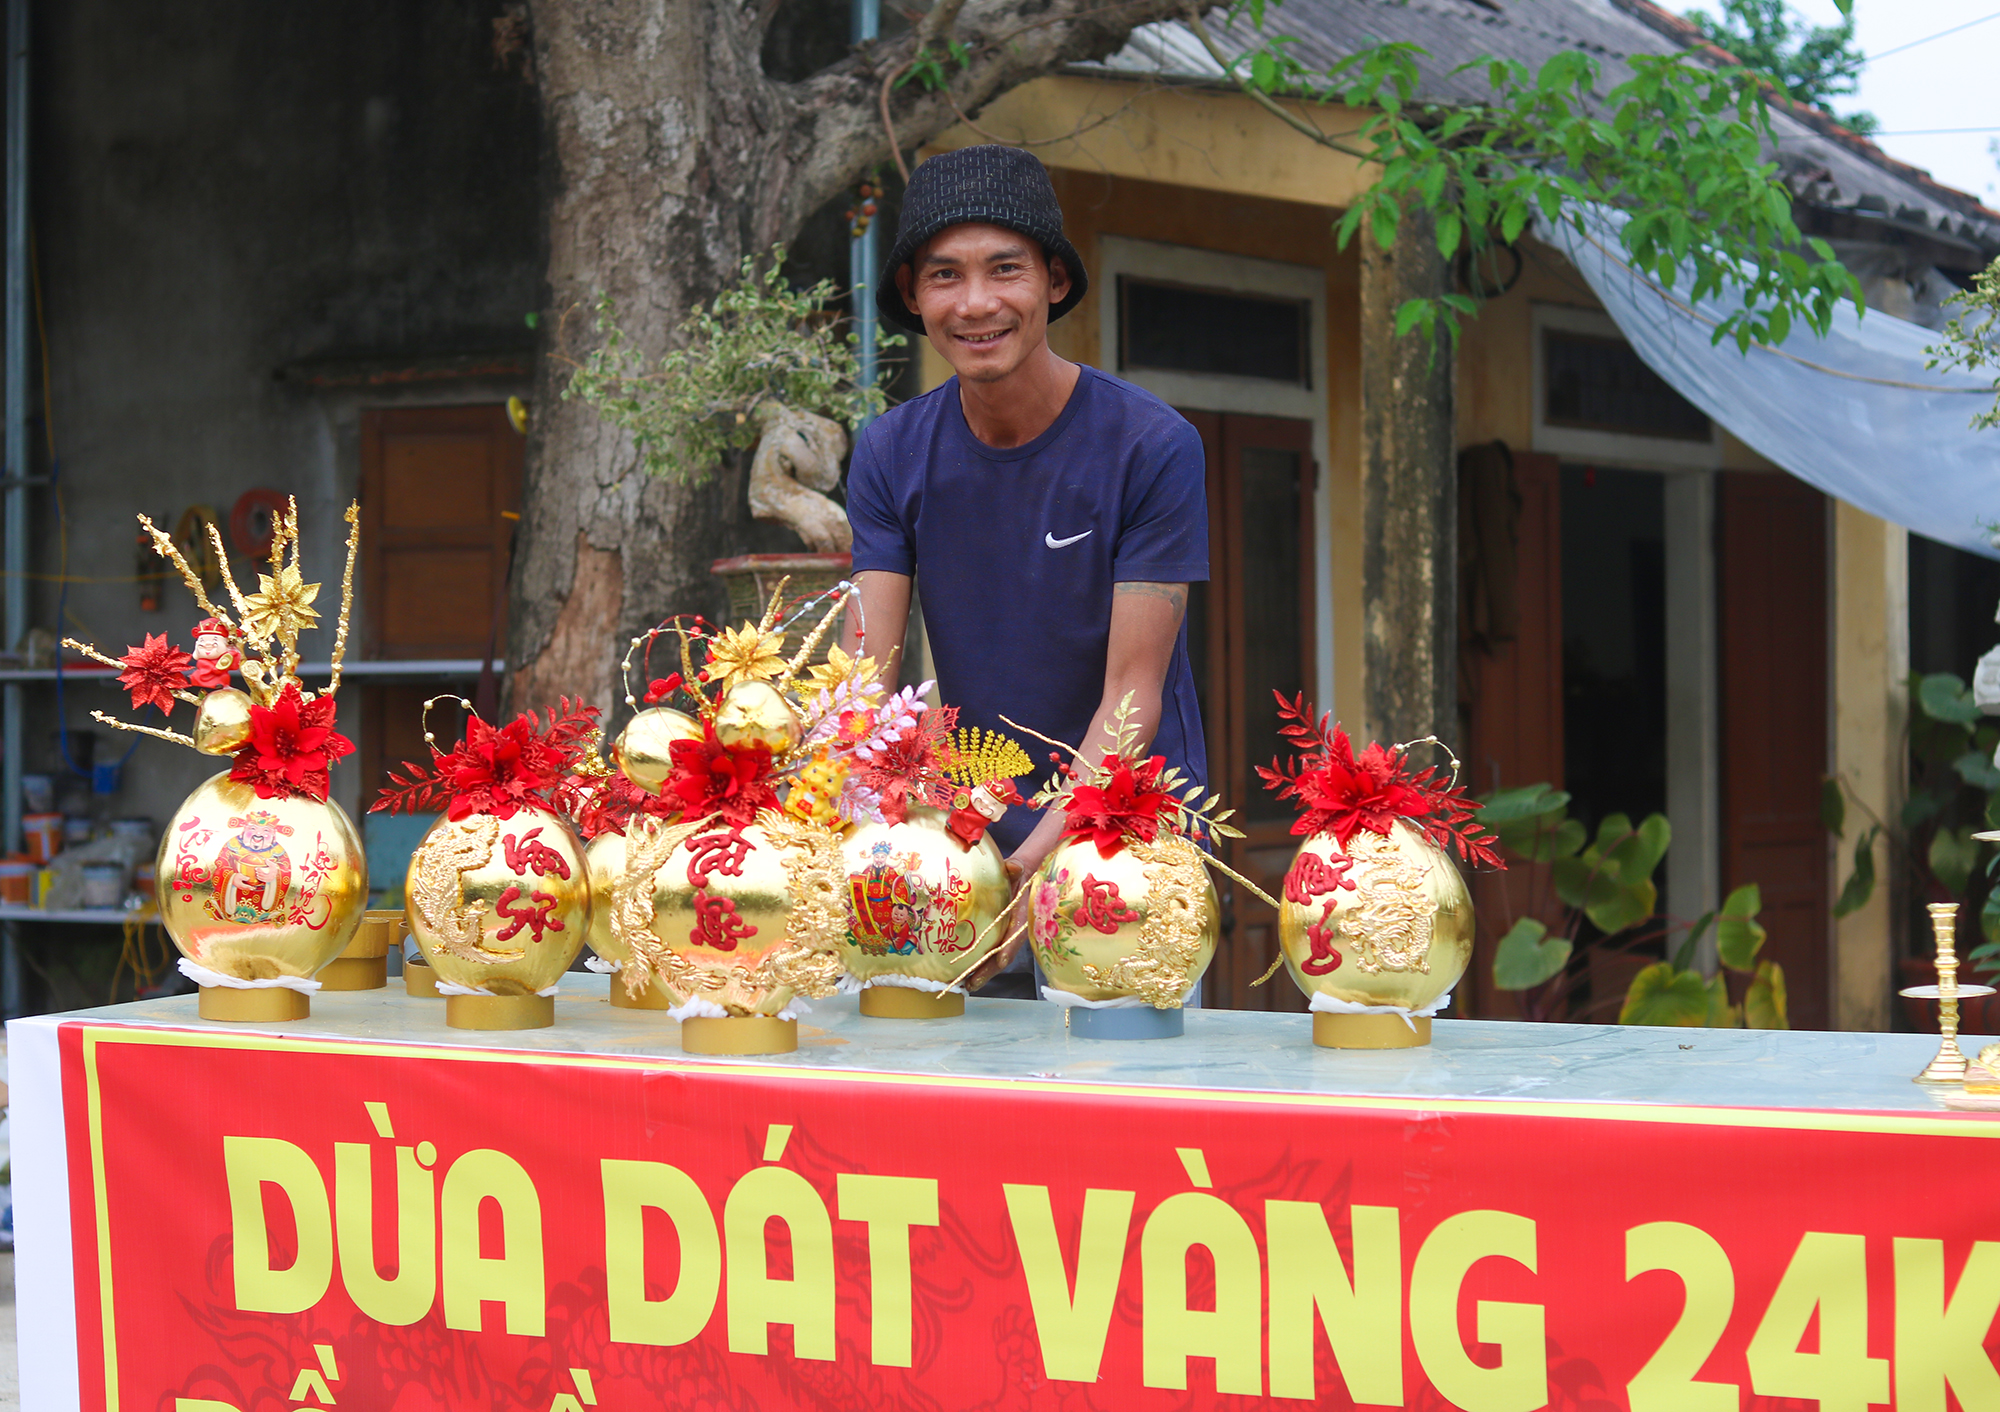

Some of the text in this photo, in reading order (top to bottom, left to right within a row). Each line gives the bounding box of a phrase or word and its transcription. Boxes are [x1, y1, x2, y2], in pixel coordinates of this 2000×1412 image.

[685, 829, 758, 951] Tài Lộc
[1073, 872, 1140, 934] Lộc
[223, 1101, 2000, 1412] DỪA DÁT VÀNG 24K
